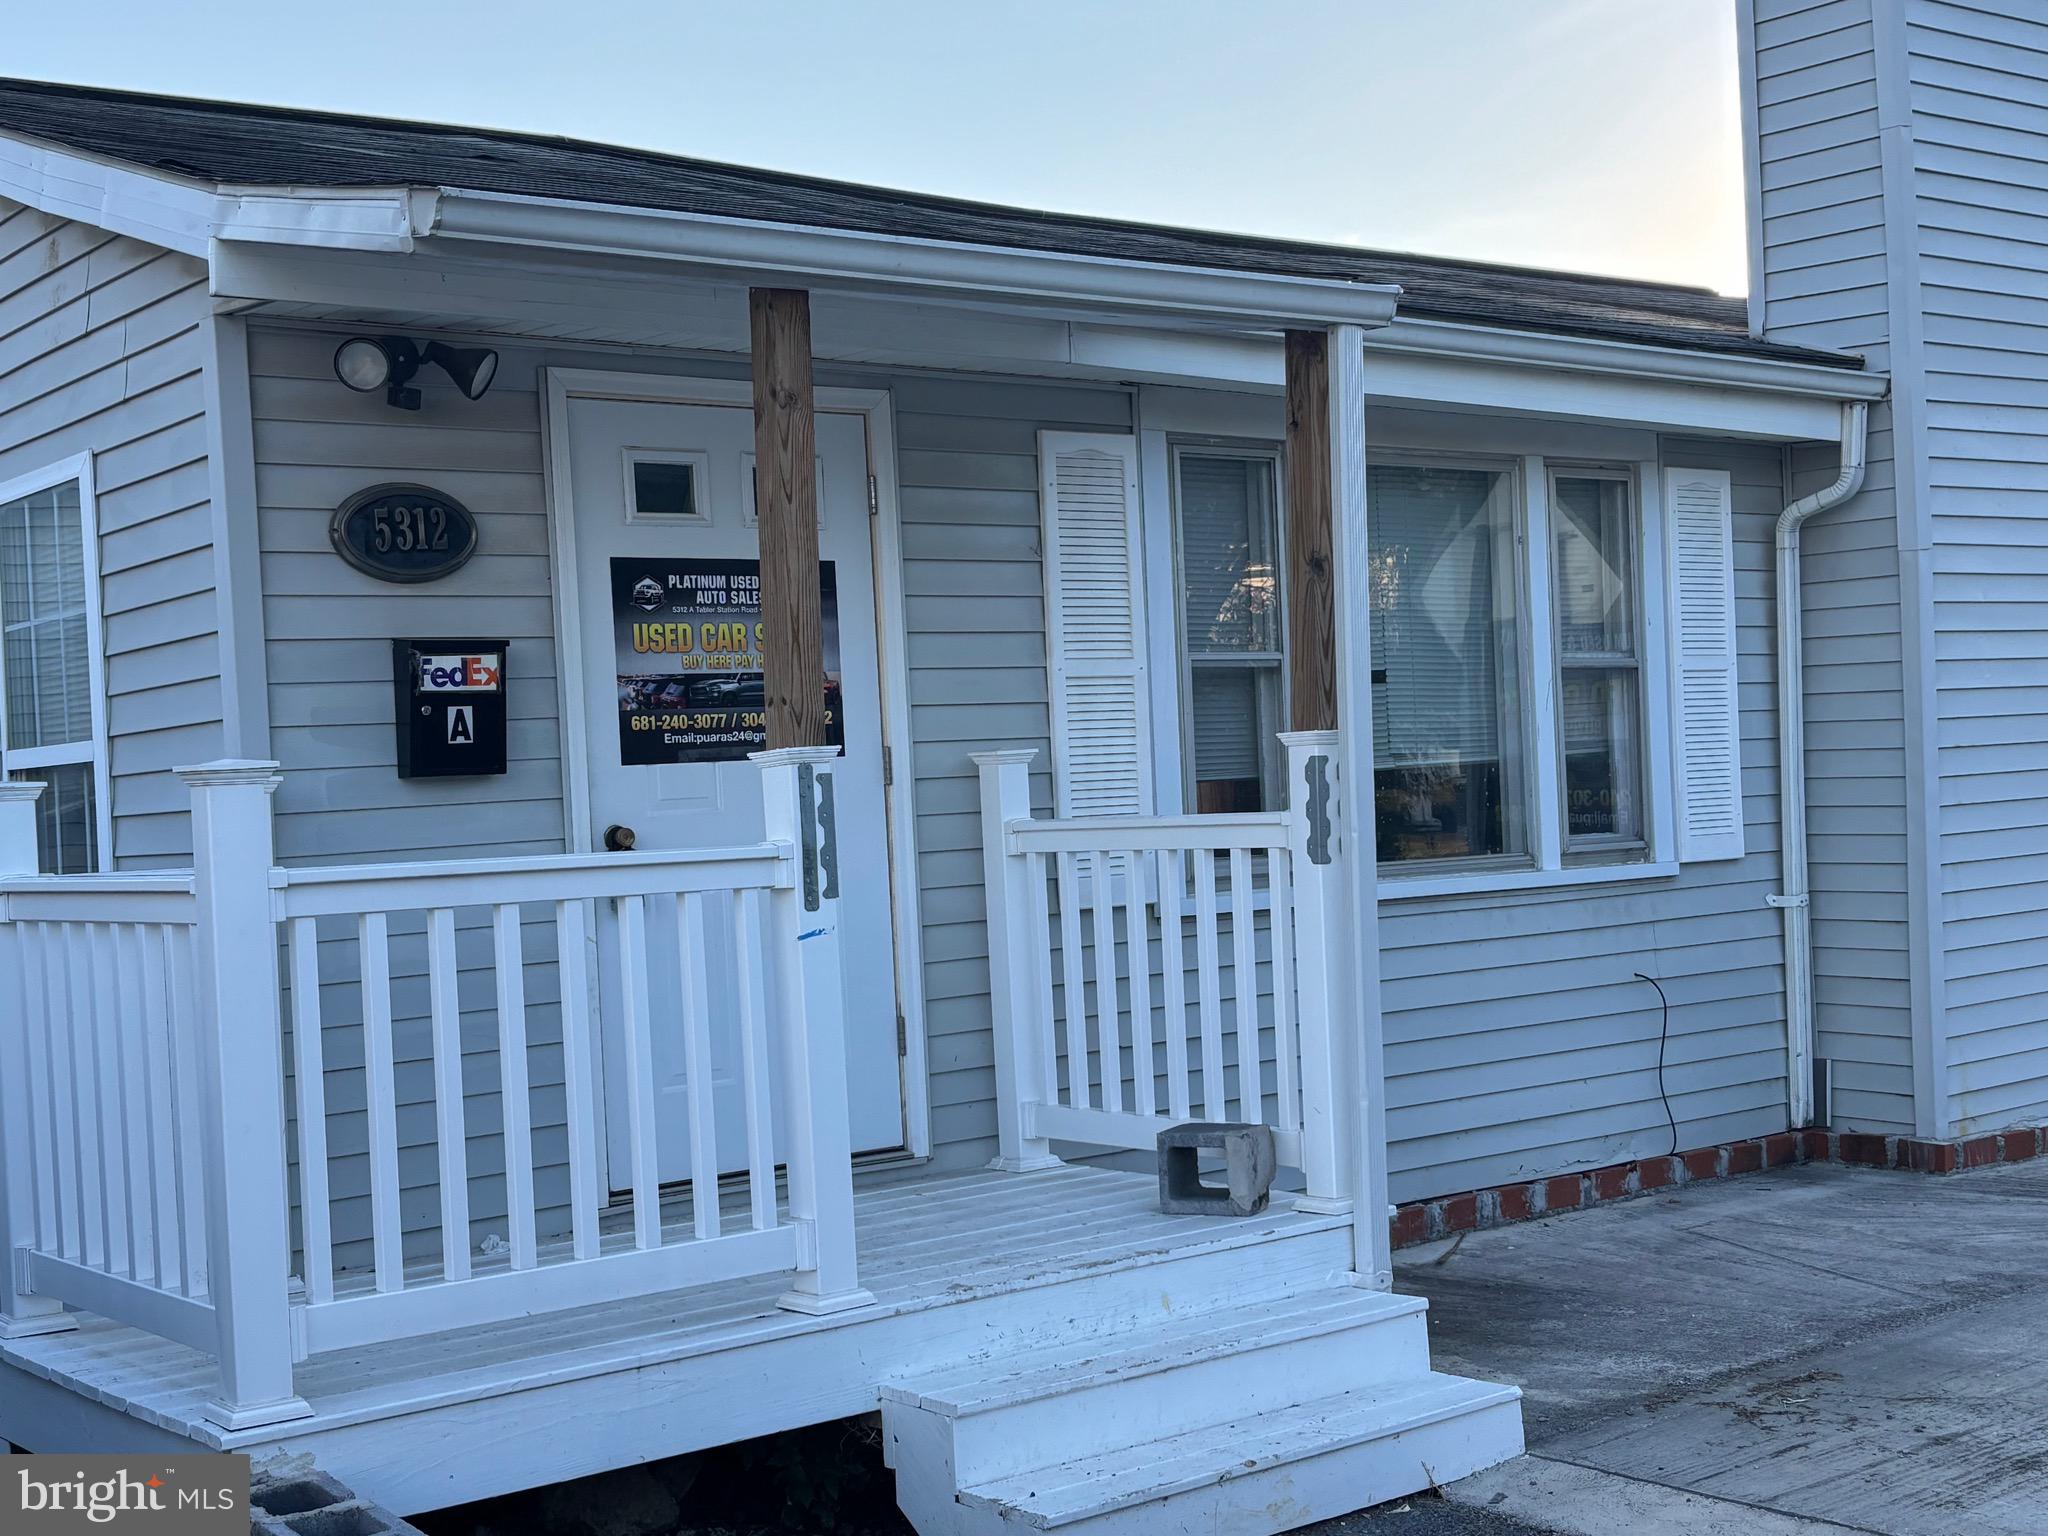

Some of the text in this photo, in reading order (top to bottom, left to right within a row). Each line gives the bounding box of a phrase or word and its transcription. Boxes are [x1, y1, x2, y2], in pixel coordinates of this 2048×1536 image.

[374, 506, 449, 552] 5312
[668, 574, 759, 589] PLATINUM USED
[696, 590, 727, 605] AUTO
[632, 622, 693, 653] USED
[700, 622, 748, 653] CAR
[420, 657, 498, 688] FedEx
[682, 655, 703, 669] BUY
[705, 655, 732, 669] HERE
[735, 655, 755, 669] PAY
[450, 708, 472, 741] A
[631, 713, 727, 731] 681-240-3077
[741, 712, 766, 727] 304
[824, 710, 833, 725] 2
[664, 730, 766, 744] Email:puaras24@gm
